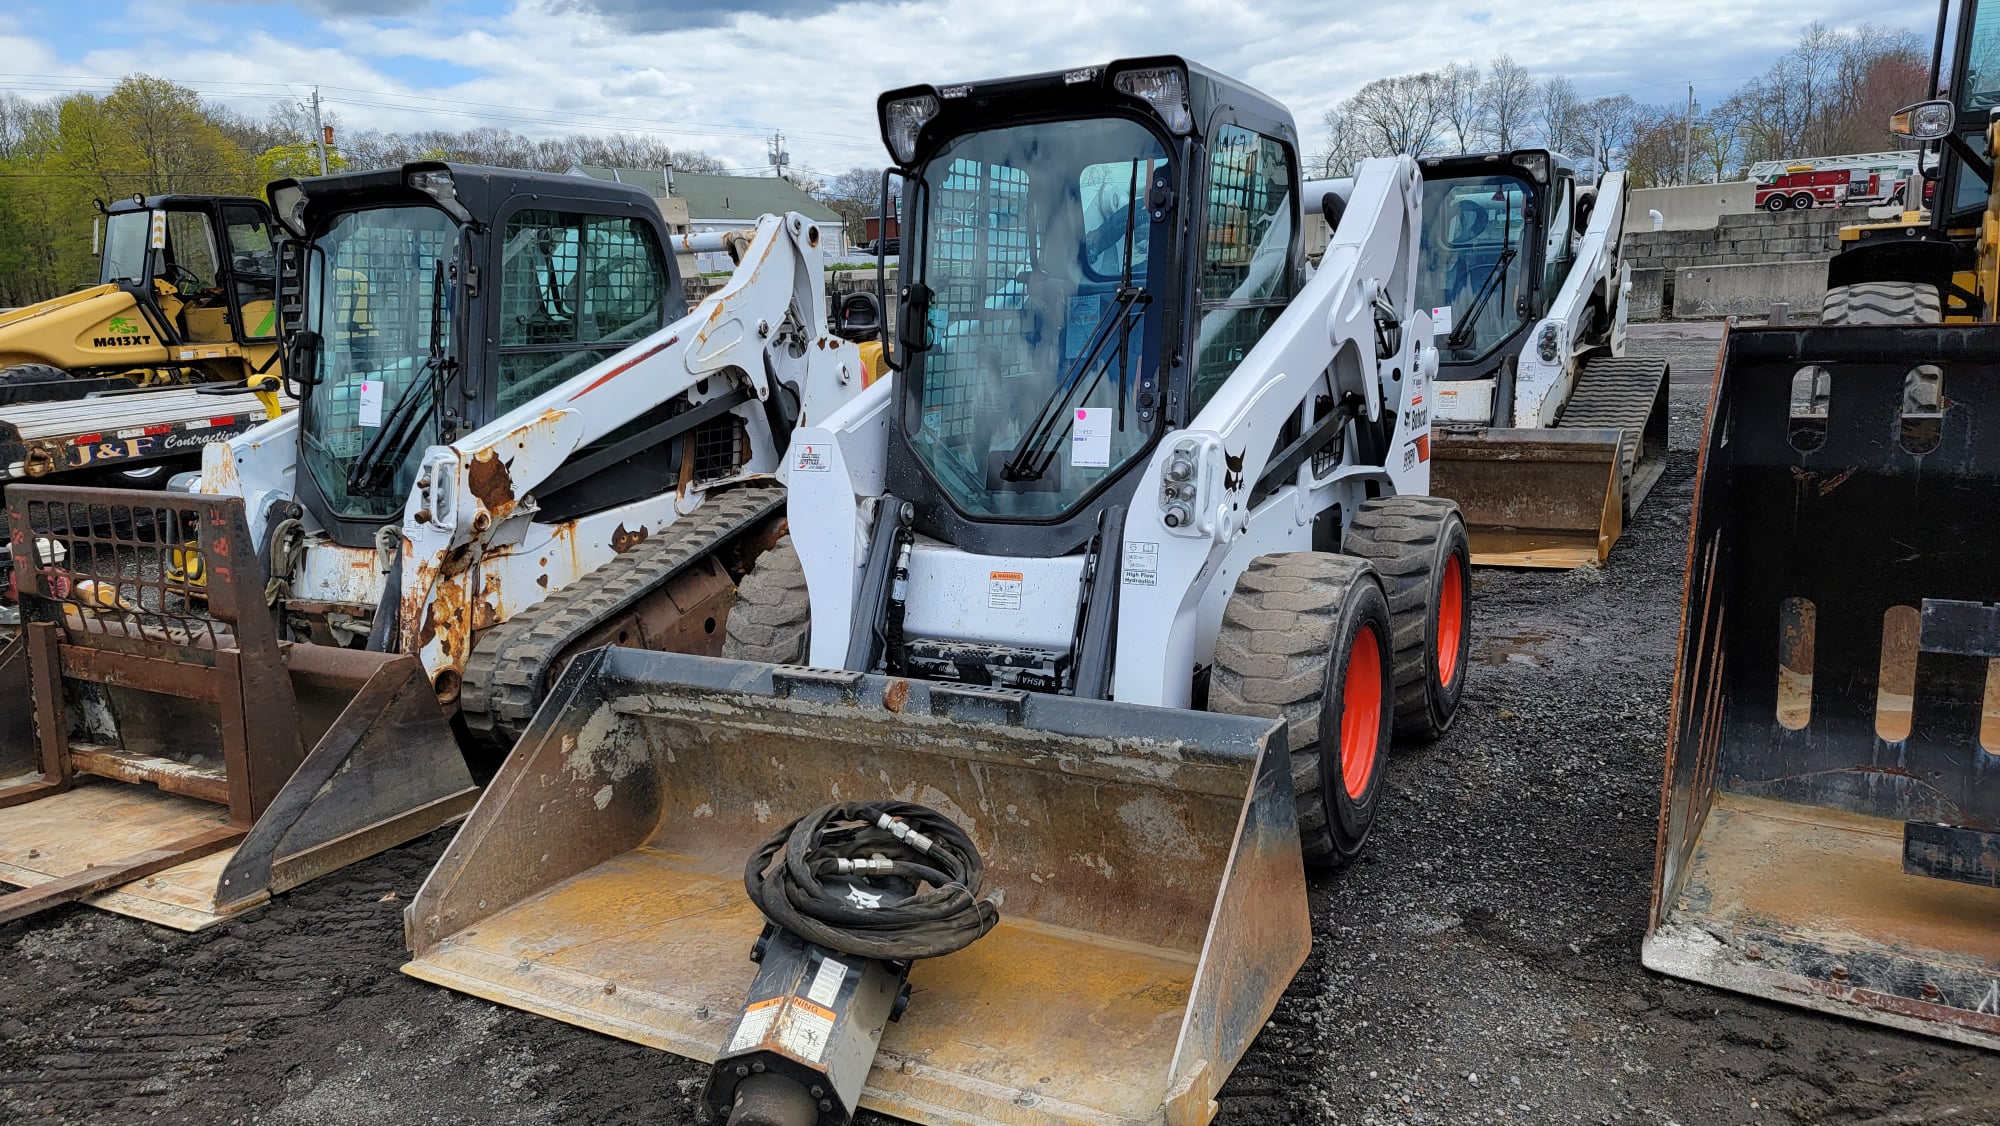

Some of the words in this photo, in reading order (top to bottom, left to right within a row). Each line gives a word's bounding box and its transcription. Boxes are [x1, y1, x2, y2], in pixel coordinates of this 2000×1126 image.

[94, 336, 150, 347] M413XT
[1412, 406, 1427, 431] Bobcat
[1022, 676, 1046, 686] MSHA
